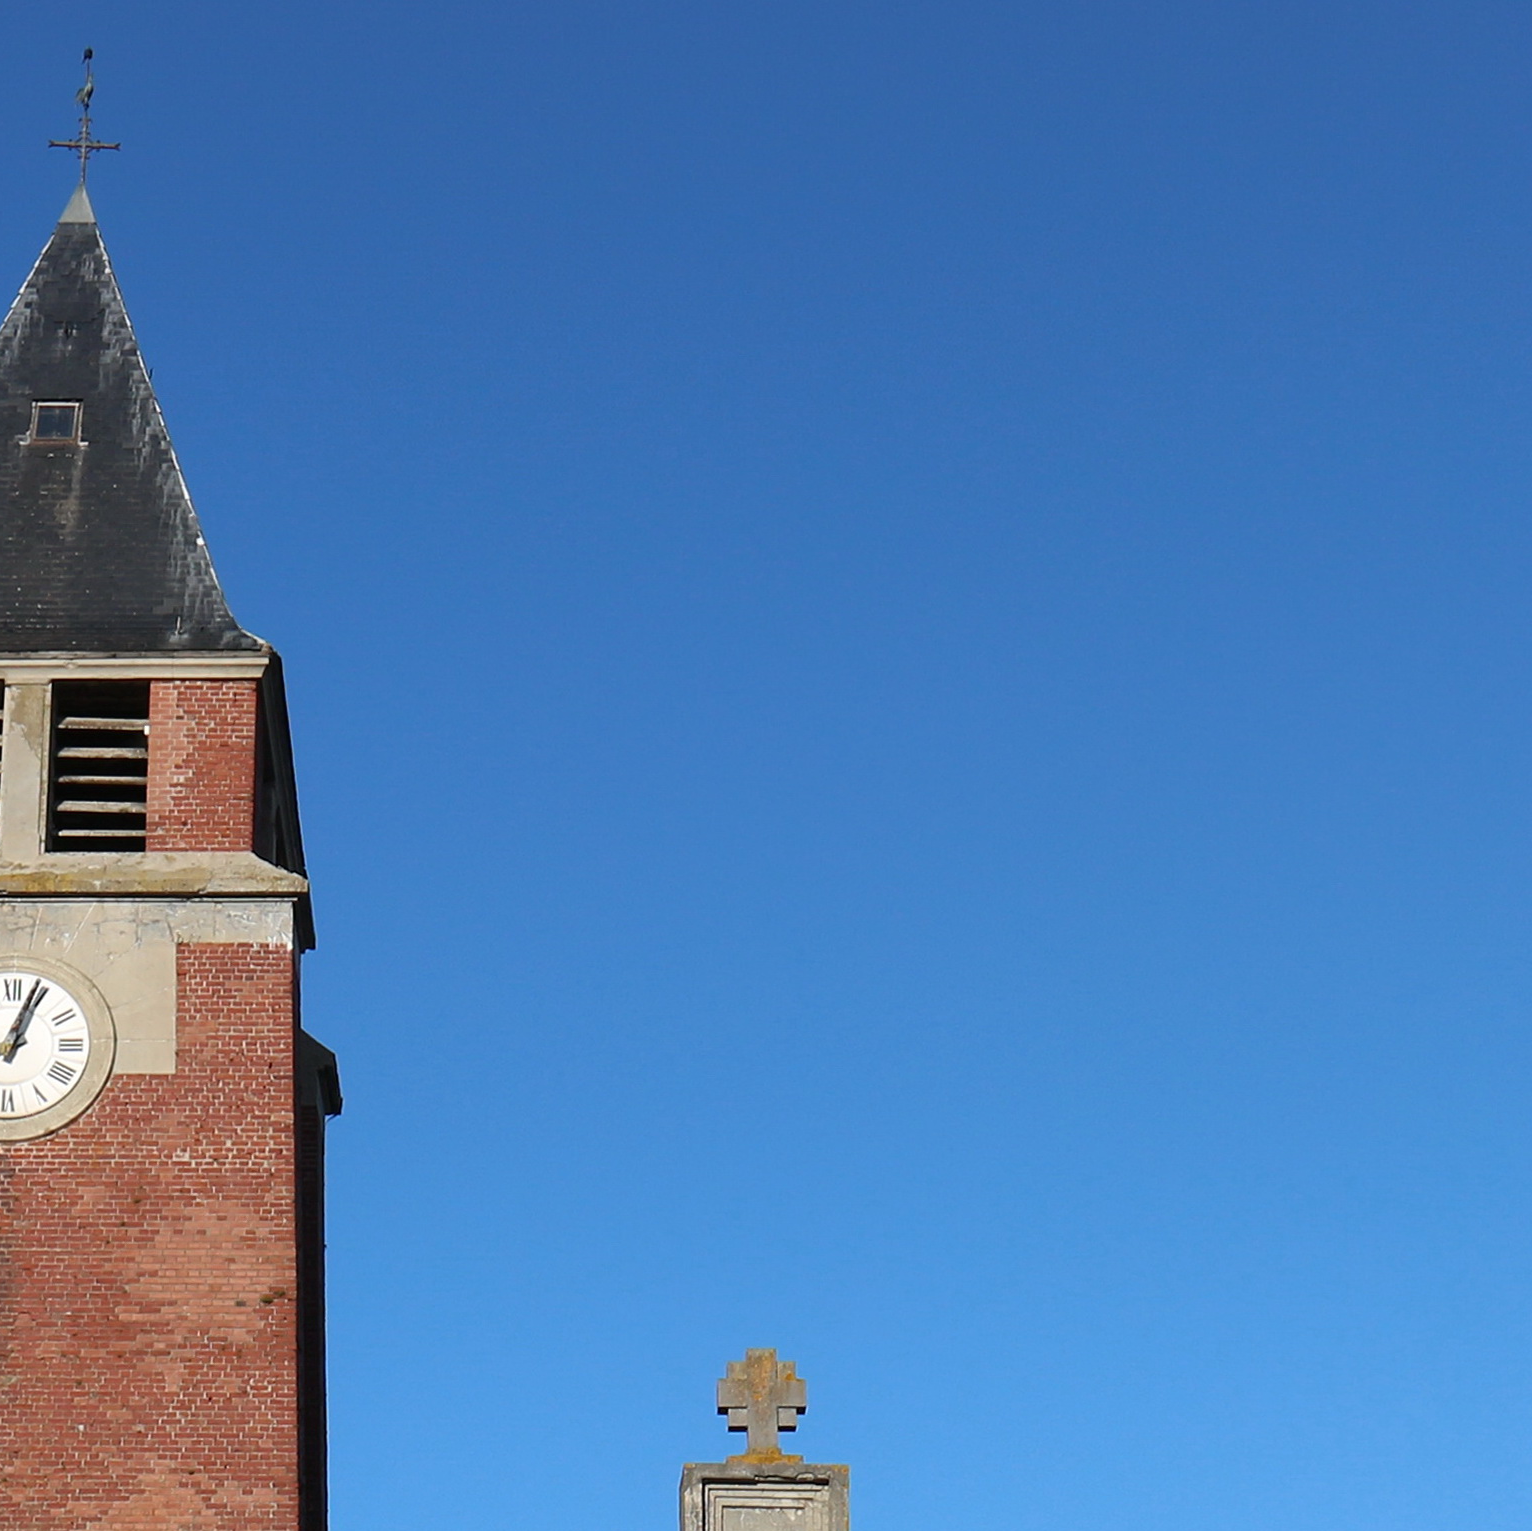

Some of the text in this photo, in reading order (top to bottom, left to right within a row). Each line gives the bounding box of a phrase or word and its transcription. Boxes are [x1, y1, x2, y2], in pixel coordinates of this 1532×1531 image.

[3, 979, 22, 1001] XII
[51, 1008, 76, 1026] II
[58, 1038, 84, 1052] III
[46, 1060, 77, 1085] IIII
[1, 1089, 15, 1112] VI
[32, 1083, 48, 1105] V
